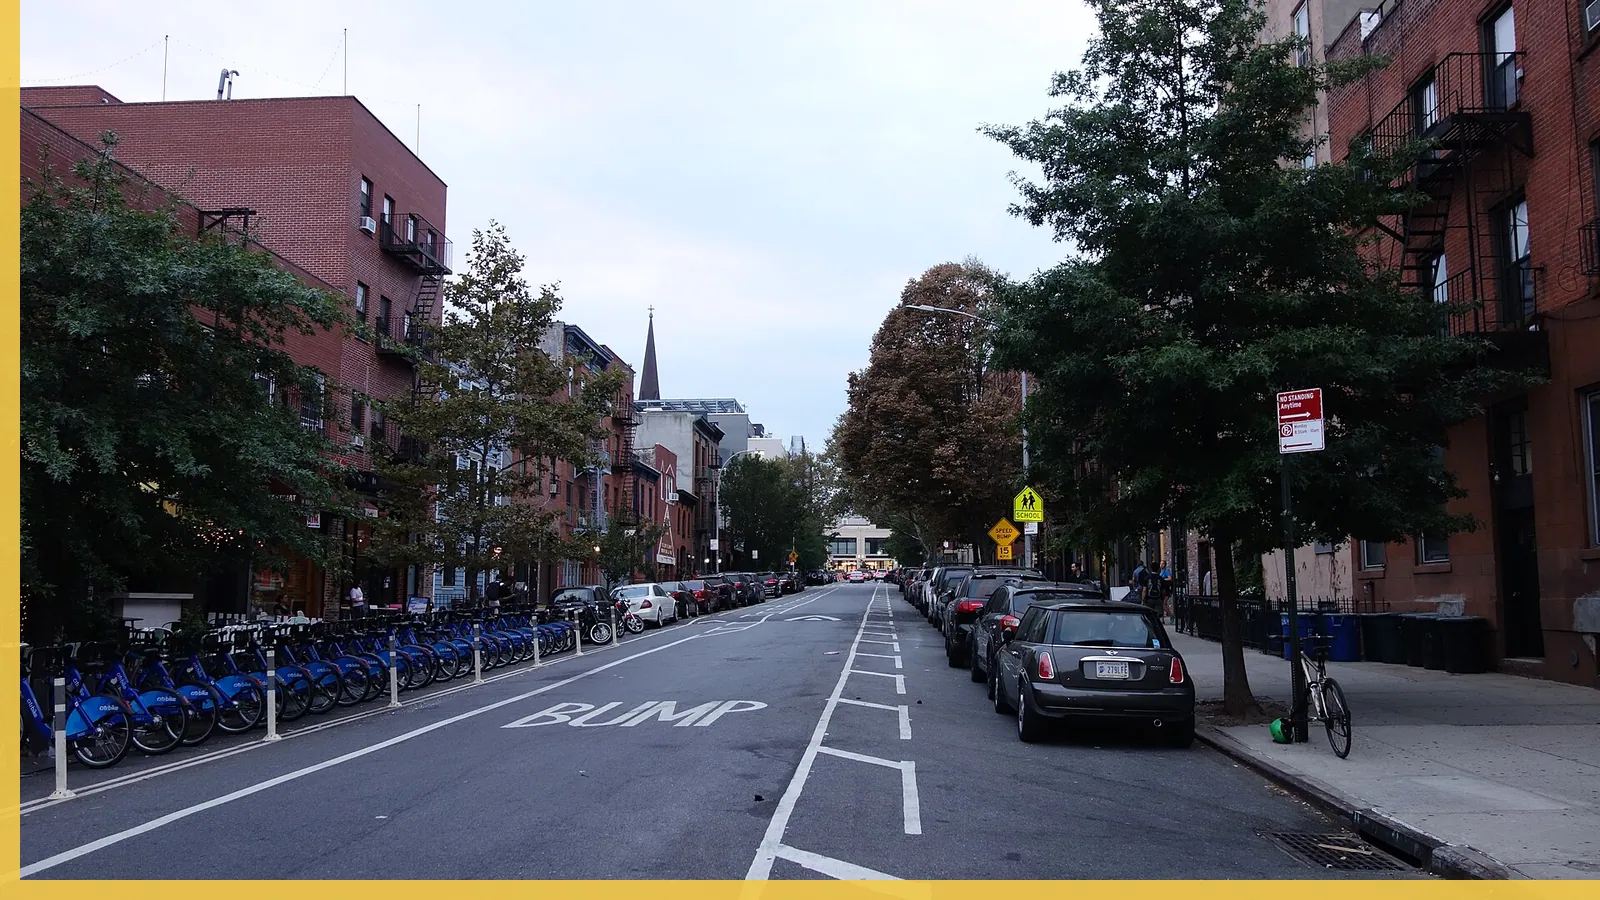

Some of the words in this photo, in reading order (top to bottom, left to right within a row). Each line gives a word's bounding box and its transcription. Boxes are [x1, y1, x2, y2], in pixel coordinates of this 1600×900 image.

[1288, 392, 1314, 402] STANDING
[1000, 546, 1010, 554] 15
[1107, 665, 1128, 674] 279LFE
[501, 699, 768, 729] BUMP
